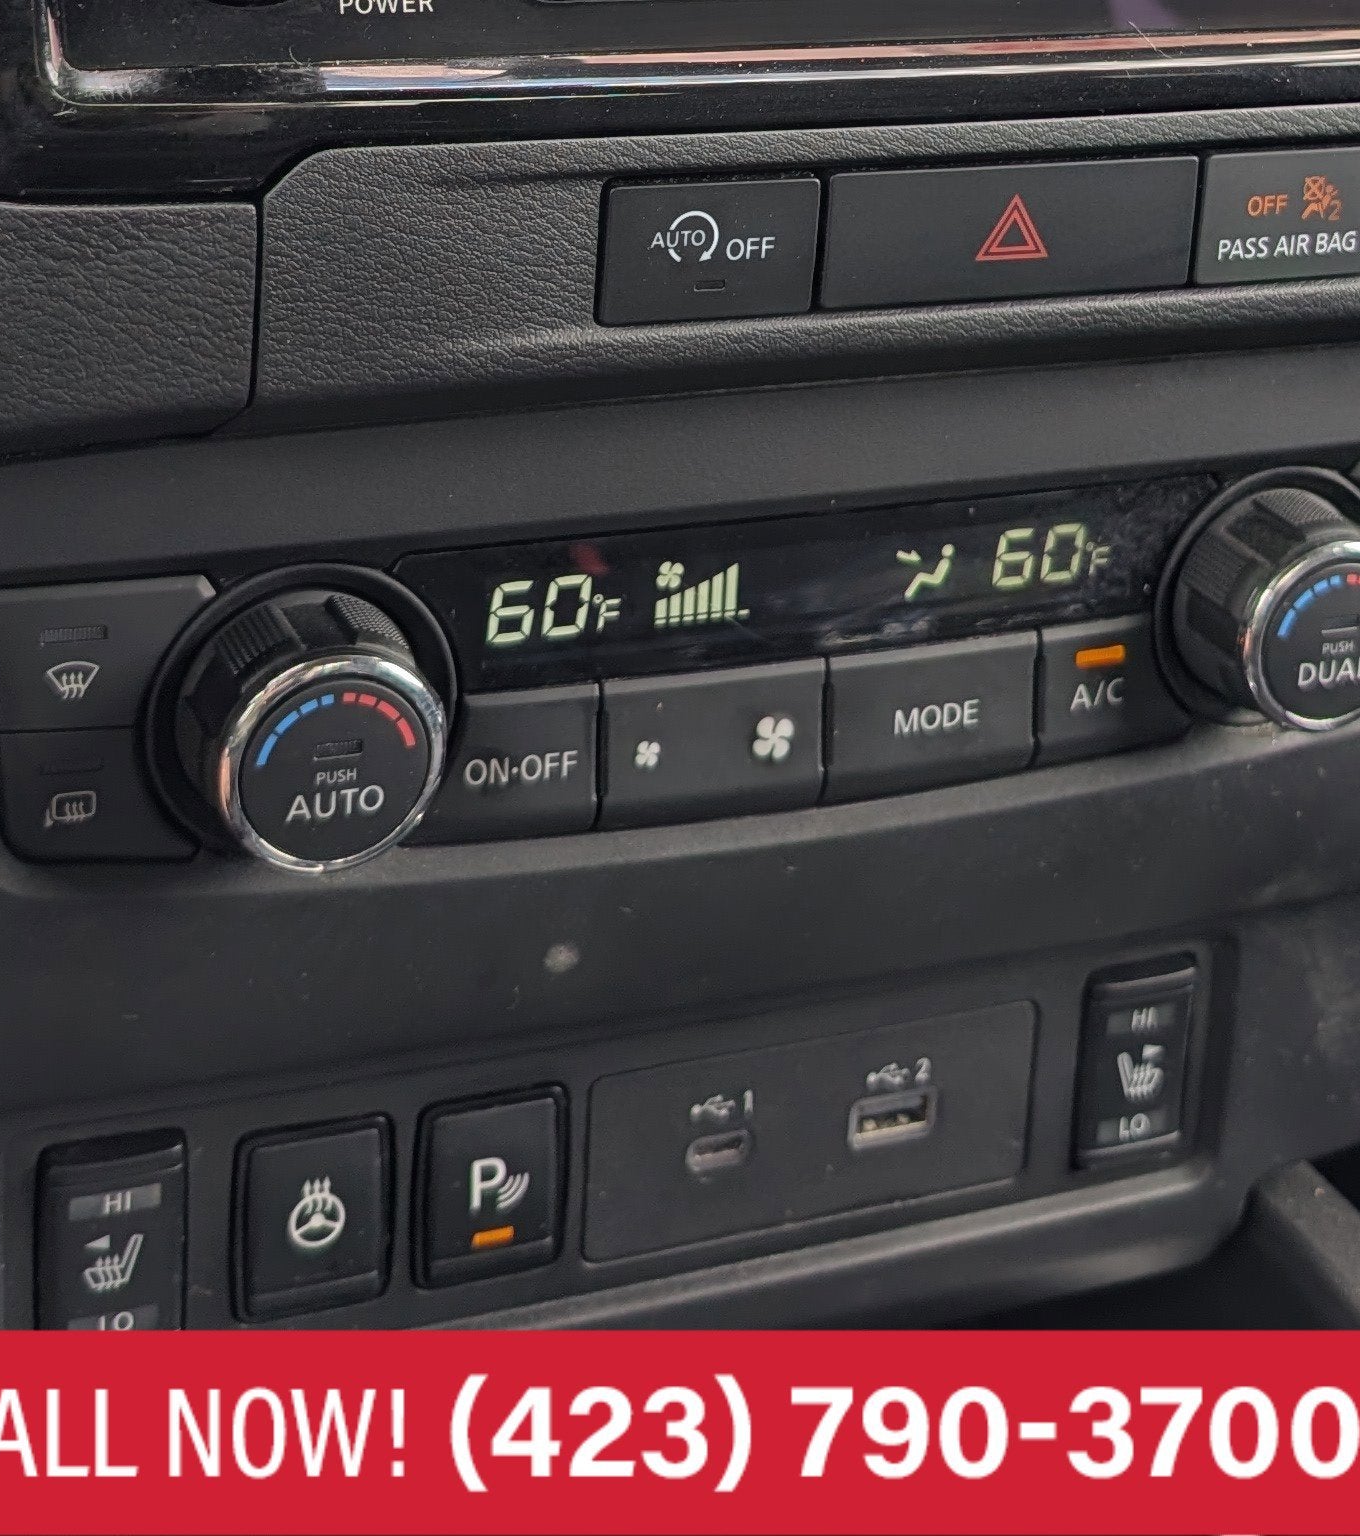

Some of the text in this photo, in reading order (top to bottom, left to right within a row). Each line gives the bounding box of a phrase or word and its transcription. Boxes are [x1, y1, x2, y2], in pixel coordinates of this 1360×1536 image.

[1246, 194, 1289, 218] OFF
[650, 229, 776, 261] AUTO OFF
[1217, 229, 1358, 261] PASS AIR BAG
[1322, 640, 1355, 655] PUSH
[1070, 677, 1125, 713] A/C
[892, 698, 980, 736] MODE
[315, 767, 358, 786] PUSH
[286, 785, 385, 822] AUTO
[1130, 1006, 1159, 1031] HI
[1117, 1113, 1151, 1142] LO
[101, 1189, 133, 1216] HI
